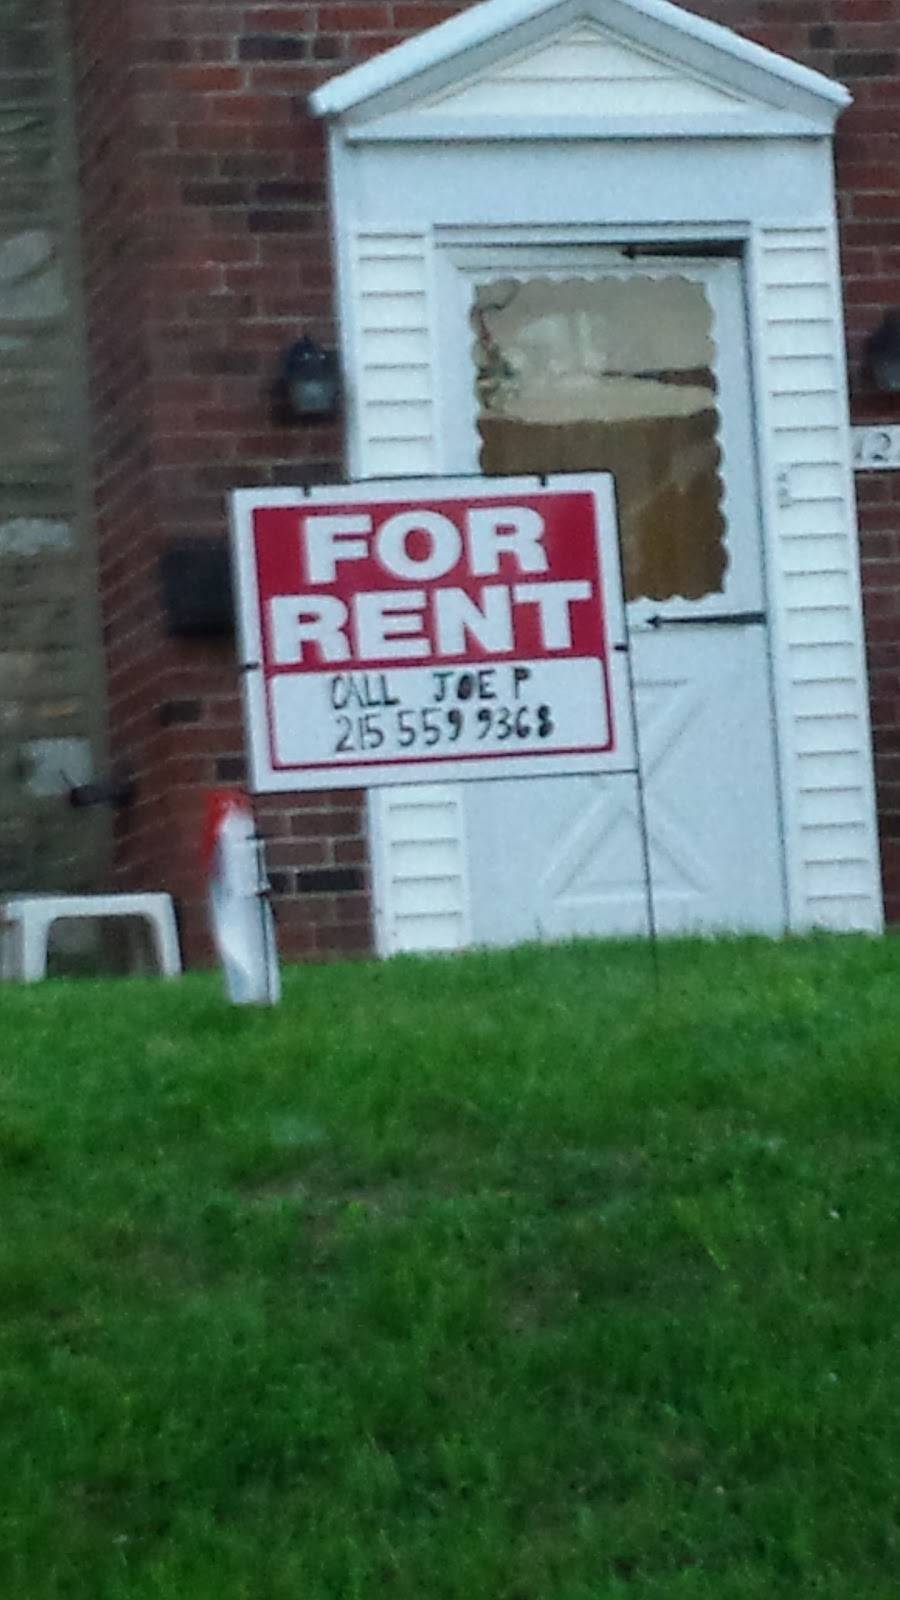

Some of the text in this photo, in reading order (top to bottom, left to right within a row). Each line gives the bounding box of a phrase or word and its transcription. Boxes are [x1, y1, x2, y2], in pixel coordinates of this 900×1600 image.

[303, 506, 549, 584] FOR
[269, 581, 592, 664] RENT
[331, 666, 532, 710] CALL JOE P
[335, 704, 553, 752] 215 559 9368
